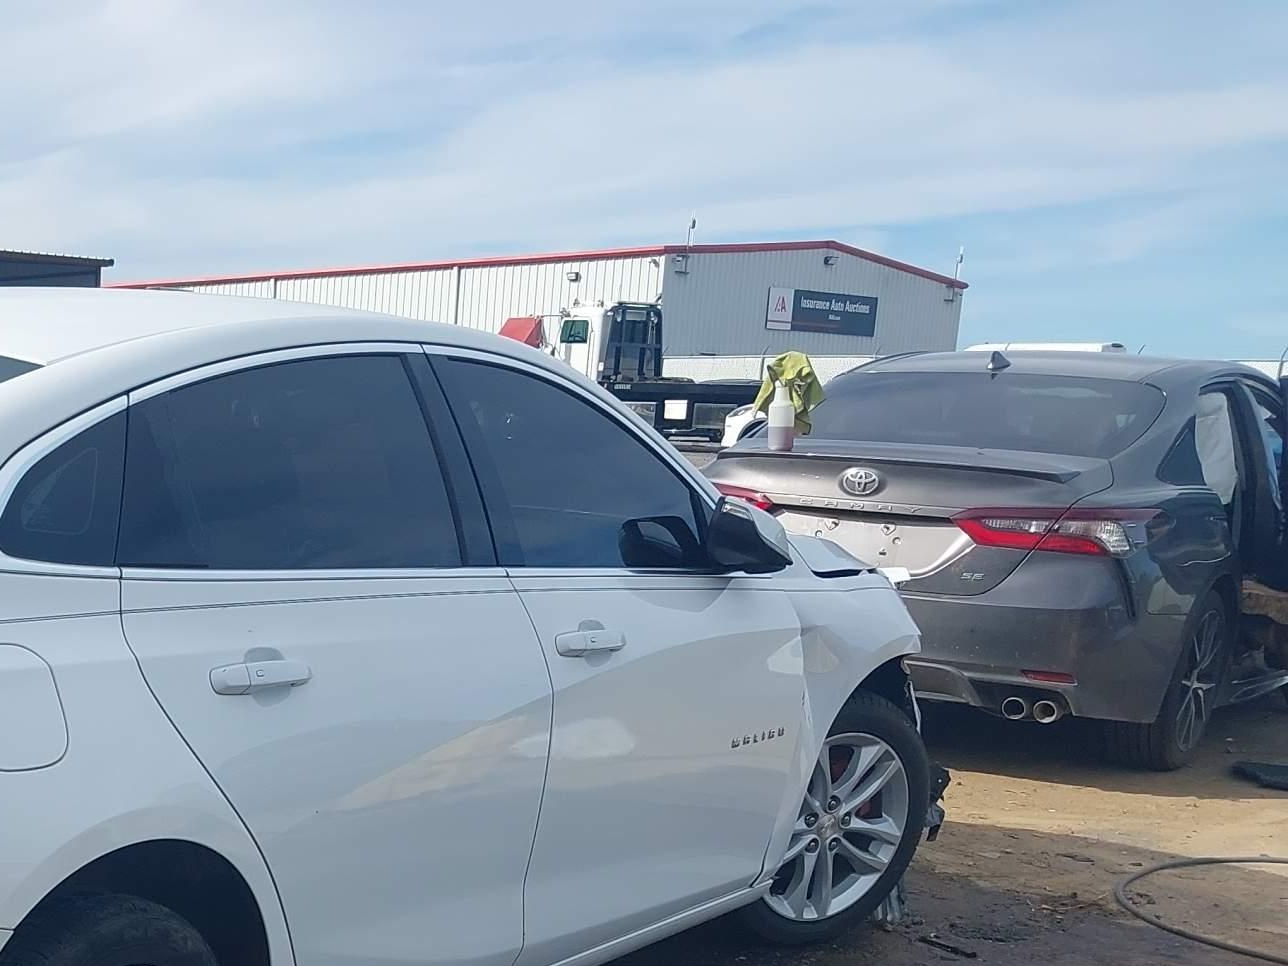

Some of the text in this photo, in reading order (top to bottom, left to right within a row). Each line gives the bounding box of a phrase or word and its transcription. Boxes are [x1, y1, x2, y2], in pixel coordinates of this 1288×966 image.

[800, 296, 871, 314] Insurance Auto Auctions
[799, 497, 921, 513] CAMRY
[960, 572, 985, 581] SE
[730, 725, 785, 749] MALIBU
